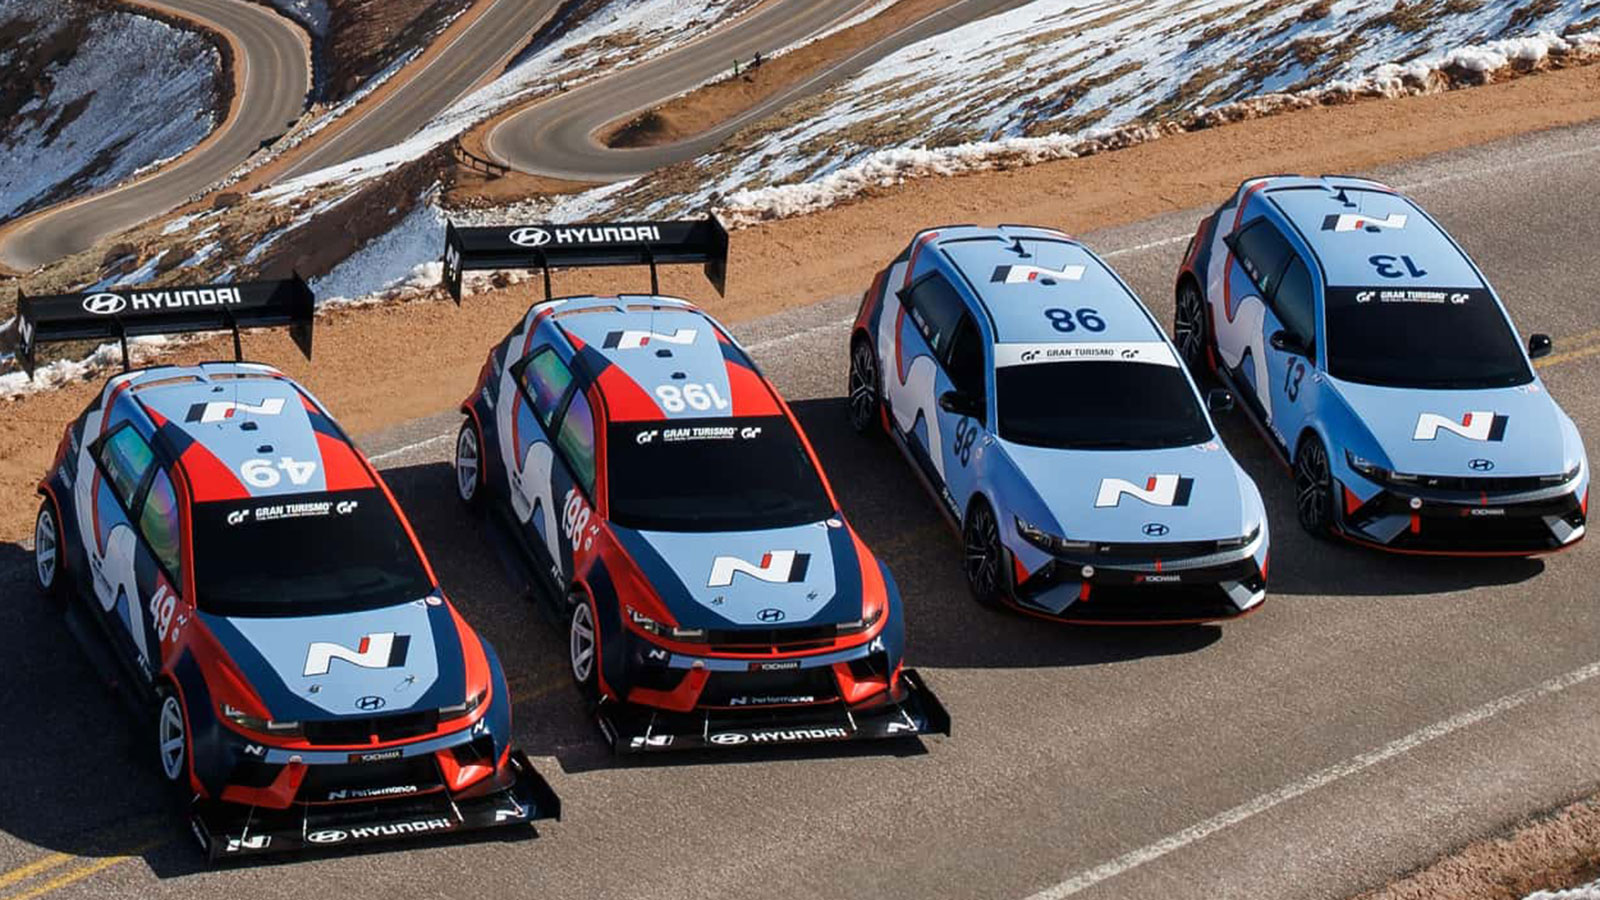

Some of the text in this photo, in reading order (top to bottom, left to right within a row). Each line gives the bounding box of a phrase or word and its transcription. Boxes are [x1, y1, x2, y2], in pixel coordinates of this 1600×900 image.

[555, 226, 660, 243] HYUNDAI
[1368, 254, 1428, 279] 13
[132, 287, 241, 310] HYUNDAI
[1380, 291, 1405, 300] GRAN
[1043, 307, 1107, 333] 98
[1046, 348, 1072, 357] GRAN
[1074, 348, 1114, 357] TURISMO
[1284, 356, 1305, 403] 13
[655, 383, 728, 413] 198
[663, 428, 691, 439] GRAN
[692, 426, 735, 437] TURISMO
[1412, 411, 1510, 442] N
[954, 416, 978, 468] 98
[240, 456, 317, 489] 49
[1094, 473, 1194, 508] N
[255, 505, 283, 517] GRAN
[286, 502, 330, 514] TURISMO
[562, 488, 590, 552] 198
[706, 549, 811, 588] N
[150, 584, 175, 642] 49
[303, 632, 411, 677] N
[751, 727, 847, 744] HYUNDAI
[351, 818, 452, 839] HYUNDAI
